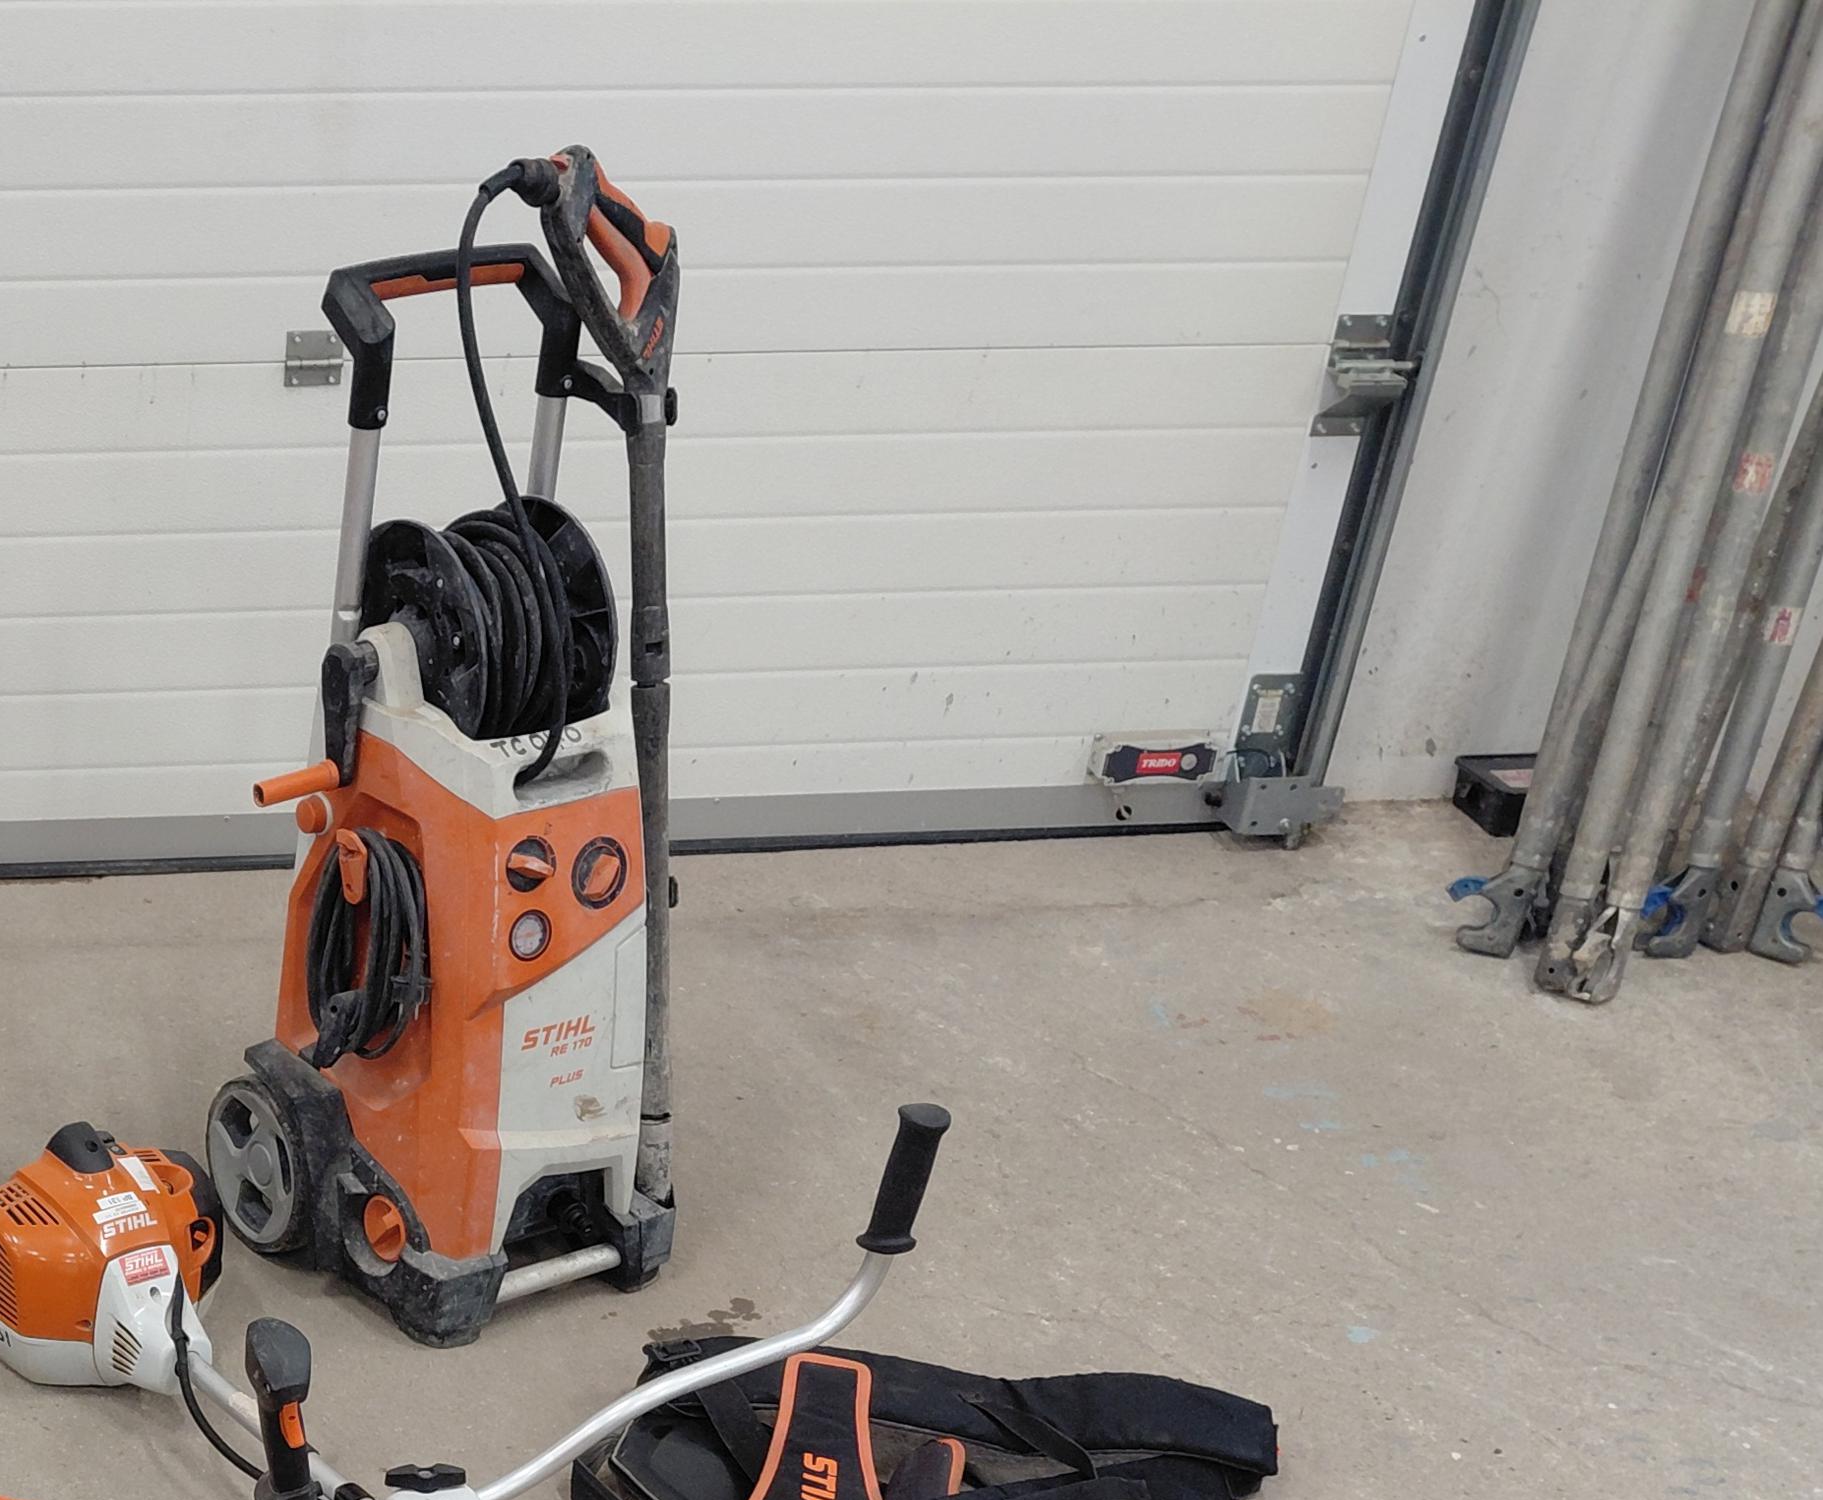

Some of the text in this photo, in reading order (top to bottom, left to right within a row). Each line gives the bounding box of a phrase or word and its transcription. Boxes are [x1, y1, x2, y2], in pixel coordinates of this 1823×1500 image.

[1141, 757, 1177, 769] TRIDO
[521, 1014, 595, 1051] STIHL
[550, 1036, 592, 1057] RE 170
[549, 1069, 584, 1088] PLUS
[102, 1212, 158, 1239] STIHL
[125, 1251, 163, 1273] STIHL
